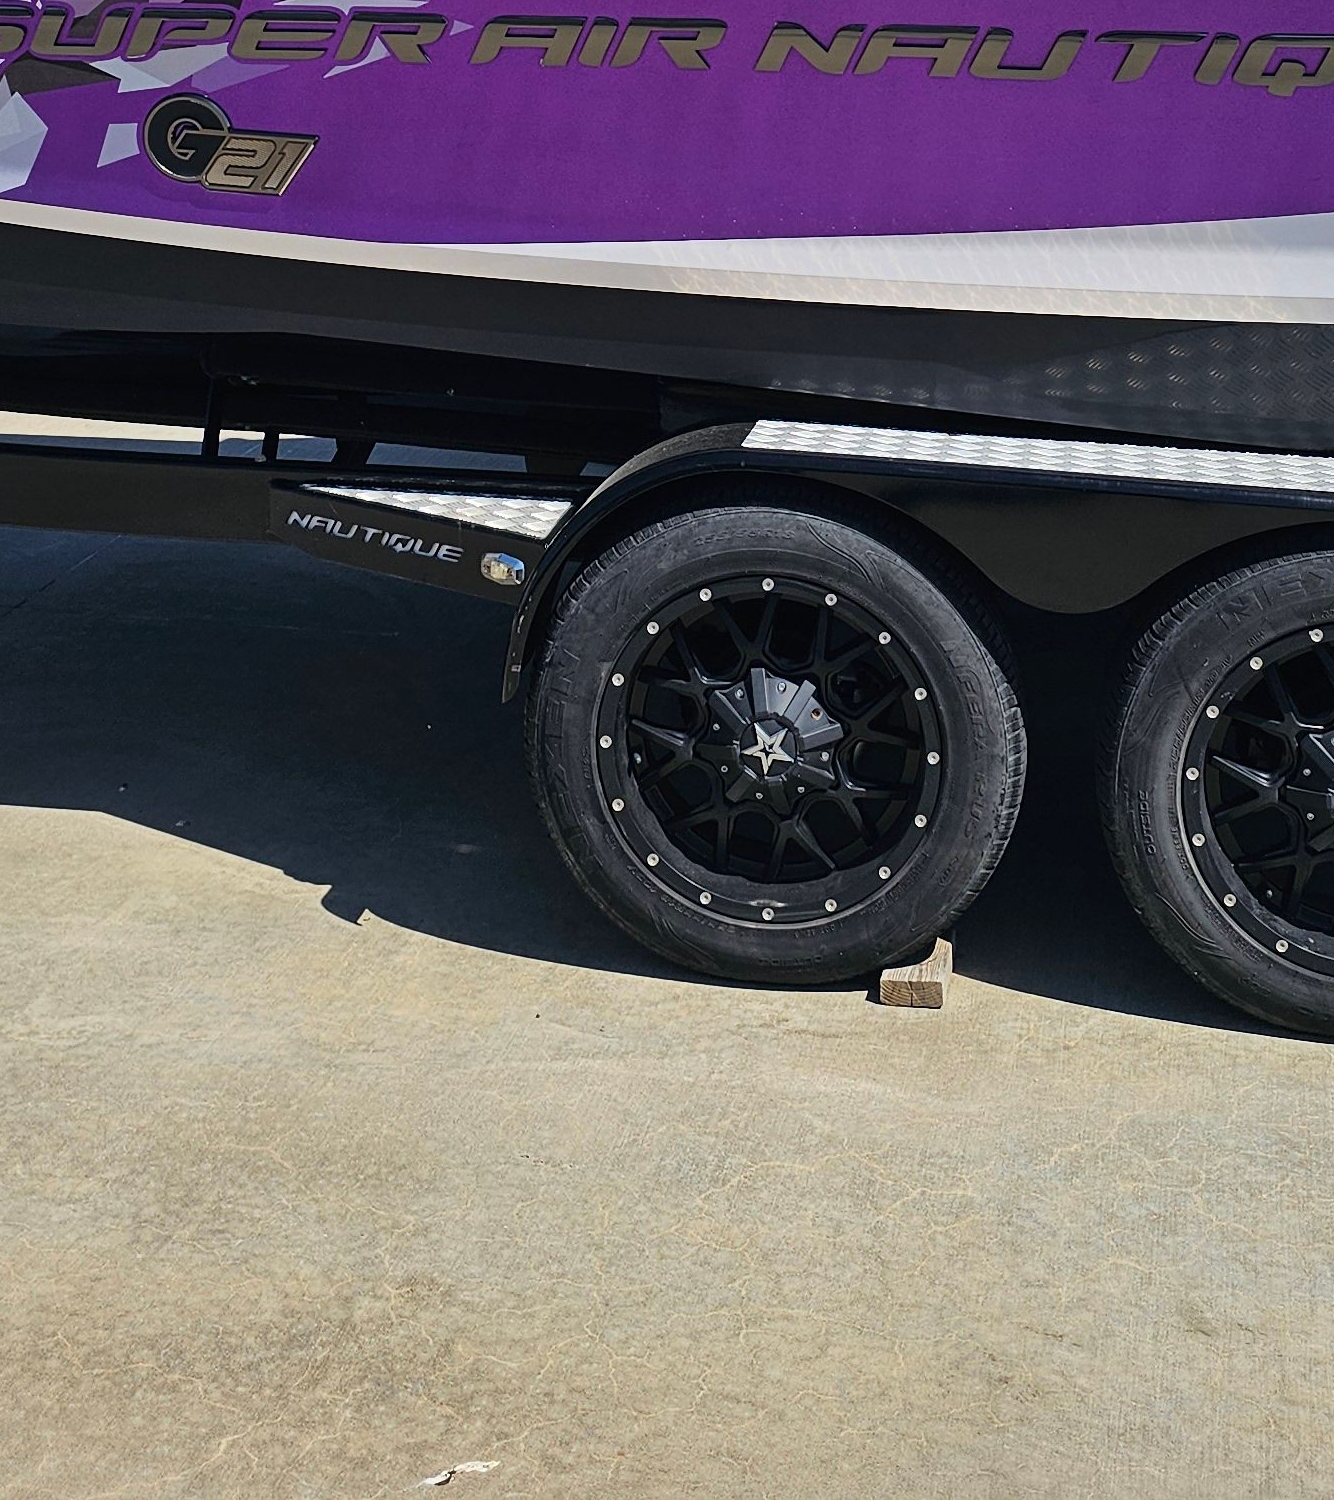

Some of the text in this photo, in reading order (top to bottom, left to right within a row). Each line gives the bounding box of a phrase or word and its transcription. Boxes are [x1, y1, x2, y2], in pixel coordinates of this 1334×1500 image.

[468, 15, 728, 71] AIR
[144, 92, 319, 197] G21
[287, 510, 465, 563] NAUTIQUE
[1137, 788, 1157, 855] OUTSIDE
